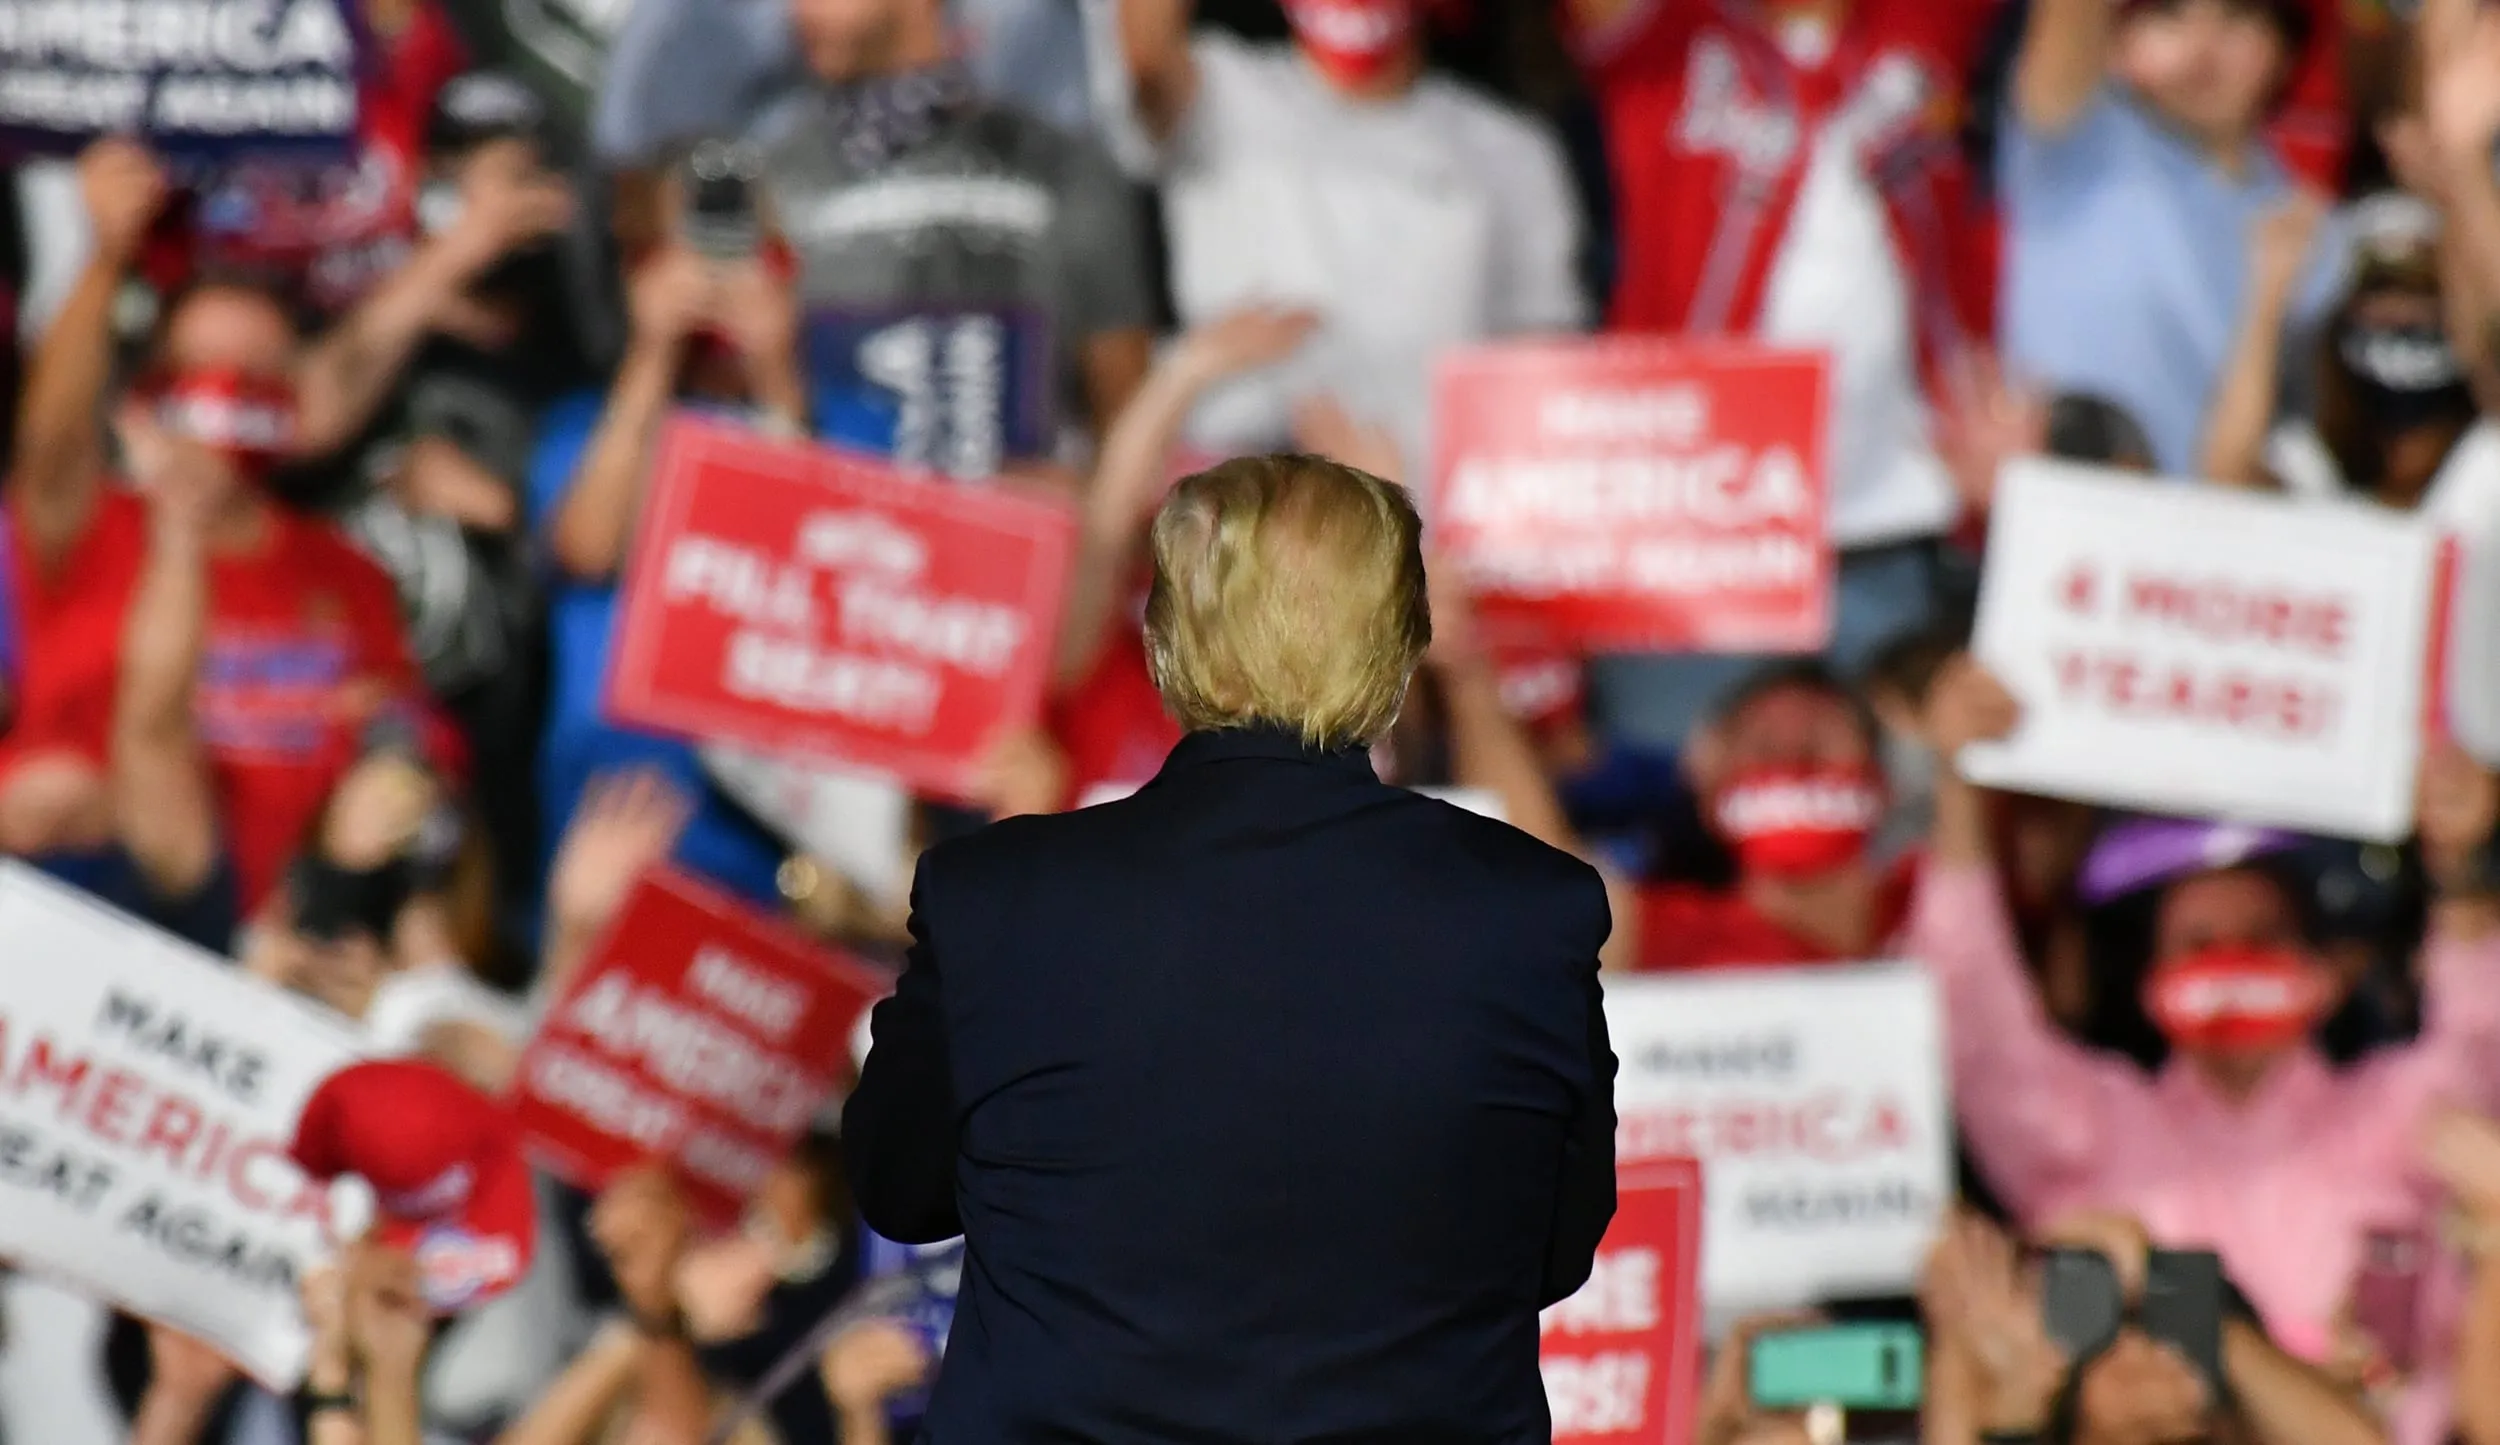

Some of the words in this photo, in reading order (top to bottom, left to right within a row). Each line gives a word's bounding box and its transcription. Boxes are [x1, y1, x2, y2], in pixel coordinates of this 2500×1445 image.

[0, 0, 353, 70] MERICA
[1445, 449, 1815, 526] AMERICA
[2057, 558, 2097, 610] 4
[2127, 568, 2356, 660] MORE
[2058, 651, 2345, 742] YEARS!
[98, 985, 269, 1105] MAKE
